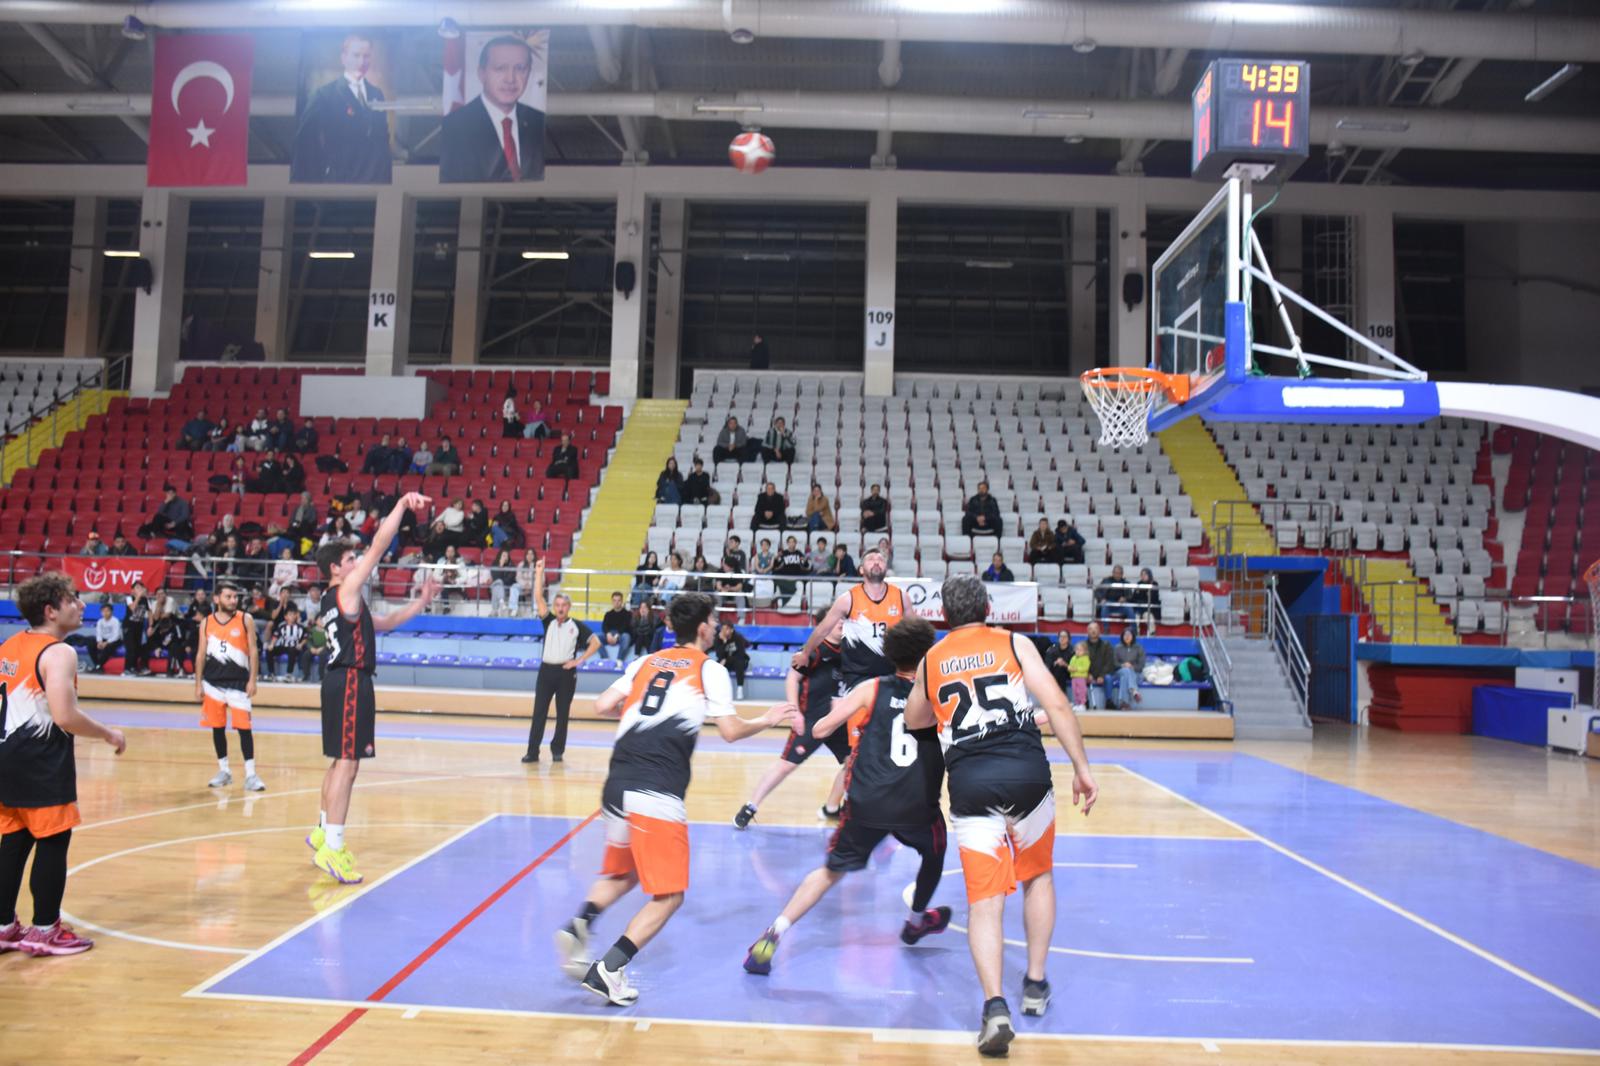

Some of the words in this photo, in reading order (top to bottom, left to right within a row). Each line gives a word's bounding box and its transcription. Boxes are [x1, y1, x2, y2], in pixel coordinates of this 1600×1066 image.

[1242, 64, 1299, 92] 4:39
[1252, 99, 1293, 148] 14
[371, 292, 395, 305] 110
[374, 313, 388, 327] K
[868, 311, 893, 324] 109
[1369, 325, 1393, 338] 108
[874, 332, 886, 346] J
[109, 570, 143, 585] TVF
[220, 641, 227, 653] 5
[639, 670, 675, 716] 8
[938, 674, 1017, 741] 25
[890, 712, 918, 767] 6
